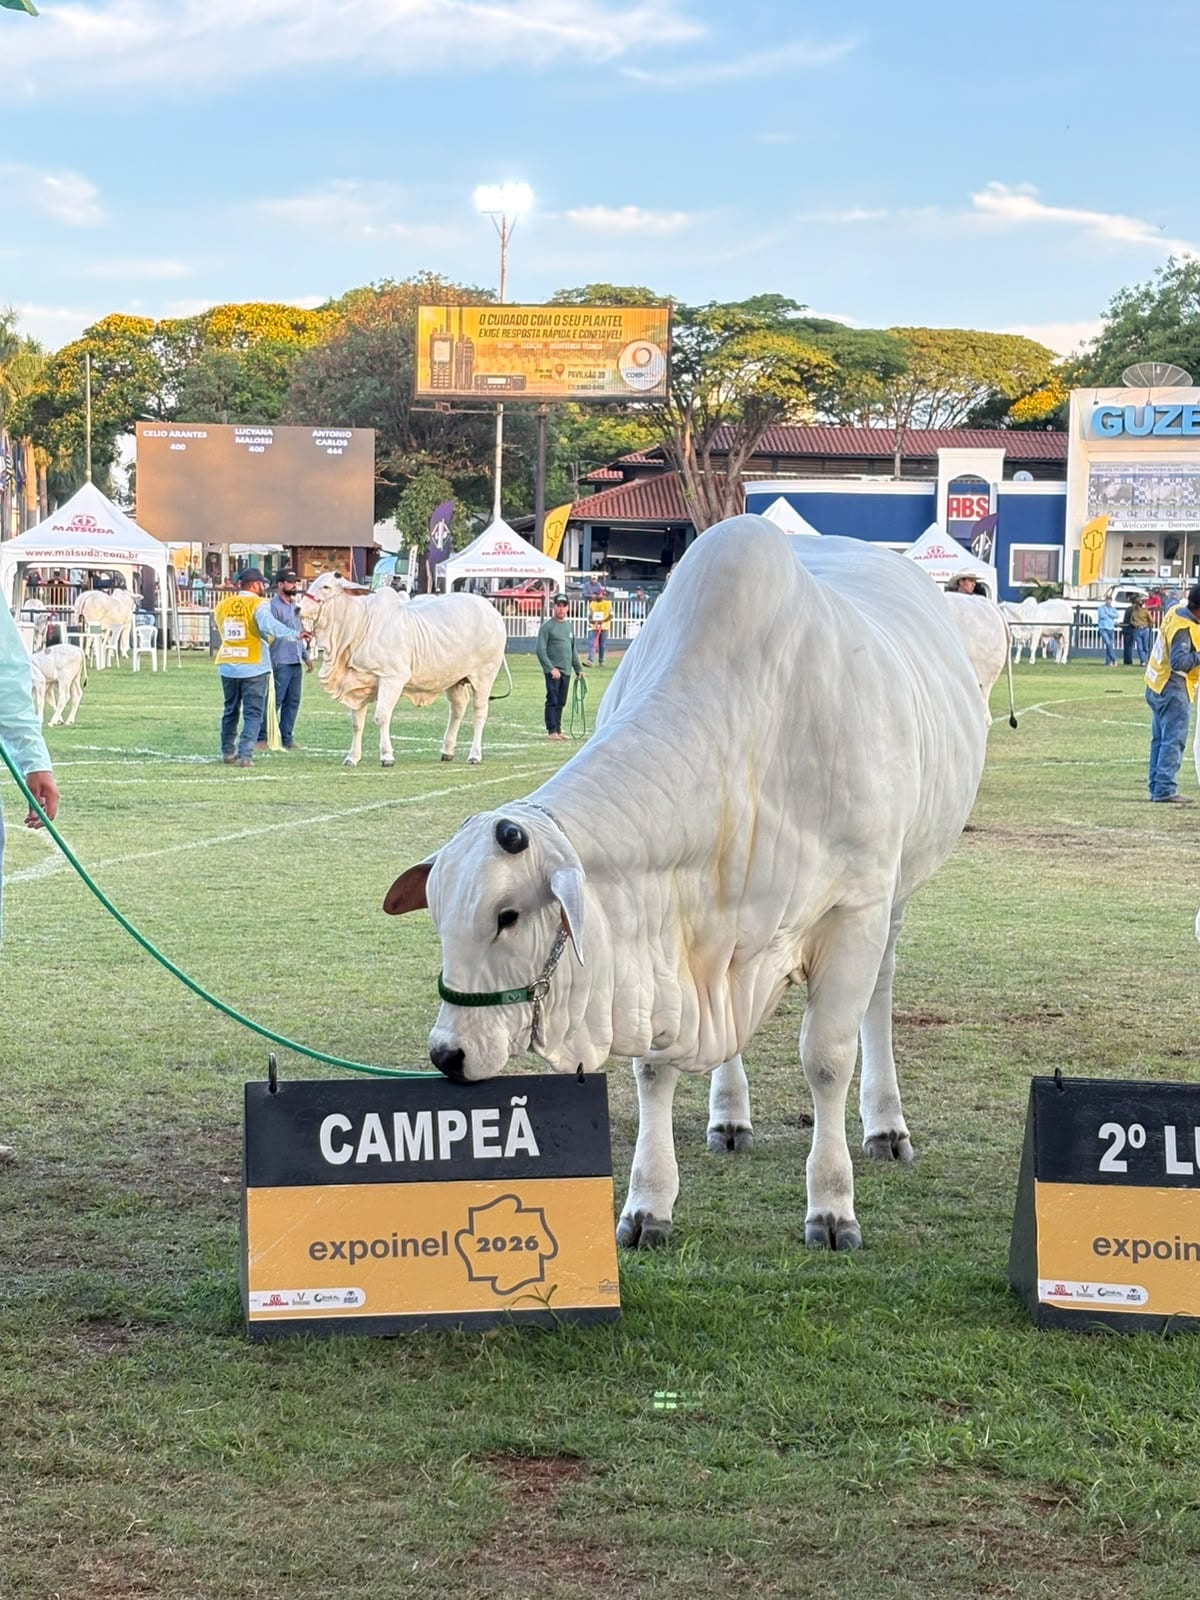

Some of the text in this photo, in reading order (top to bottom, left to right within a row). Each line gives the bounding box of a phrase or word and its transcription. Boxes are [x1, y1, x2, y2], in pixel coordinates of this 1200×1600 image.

[479, 314, 623, 327] O CUIDADO COM O SEU PLANTEL
[479, 328, 501, 338] EXIGE
[502, 328, 540, 338] RESPOSTA
[542, 326, 571, 339] RÁPIDA
[572, 329, 578, 339] E
[1092, 404, 1200, 438] GUZE
[169, 430, 207, 439] ARANTES
[235, 428, 273, 437] LUCYANA
[312, 430, 352, 438] ANTONIO
[235, 437, 272, 445] MALOSSI
[315, 438, 348, 447] CARLOS
[170, 443, 186, 451] 400
[948, 497, 989, 518] ABS
[52, 525, 115, 535] MATSUDA
[25, 550, 140, 560] www.matsuda.com.br
[319, 1095, 540, 1165] CAMPEÃ
[1098, 1122, 1200, 1175] 2º L
[308, 1230, 448, 1265] expoinel
[476, 1235, 539, 1252] 2026
